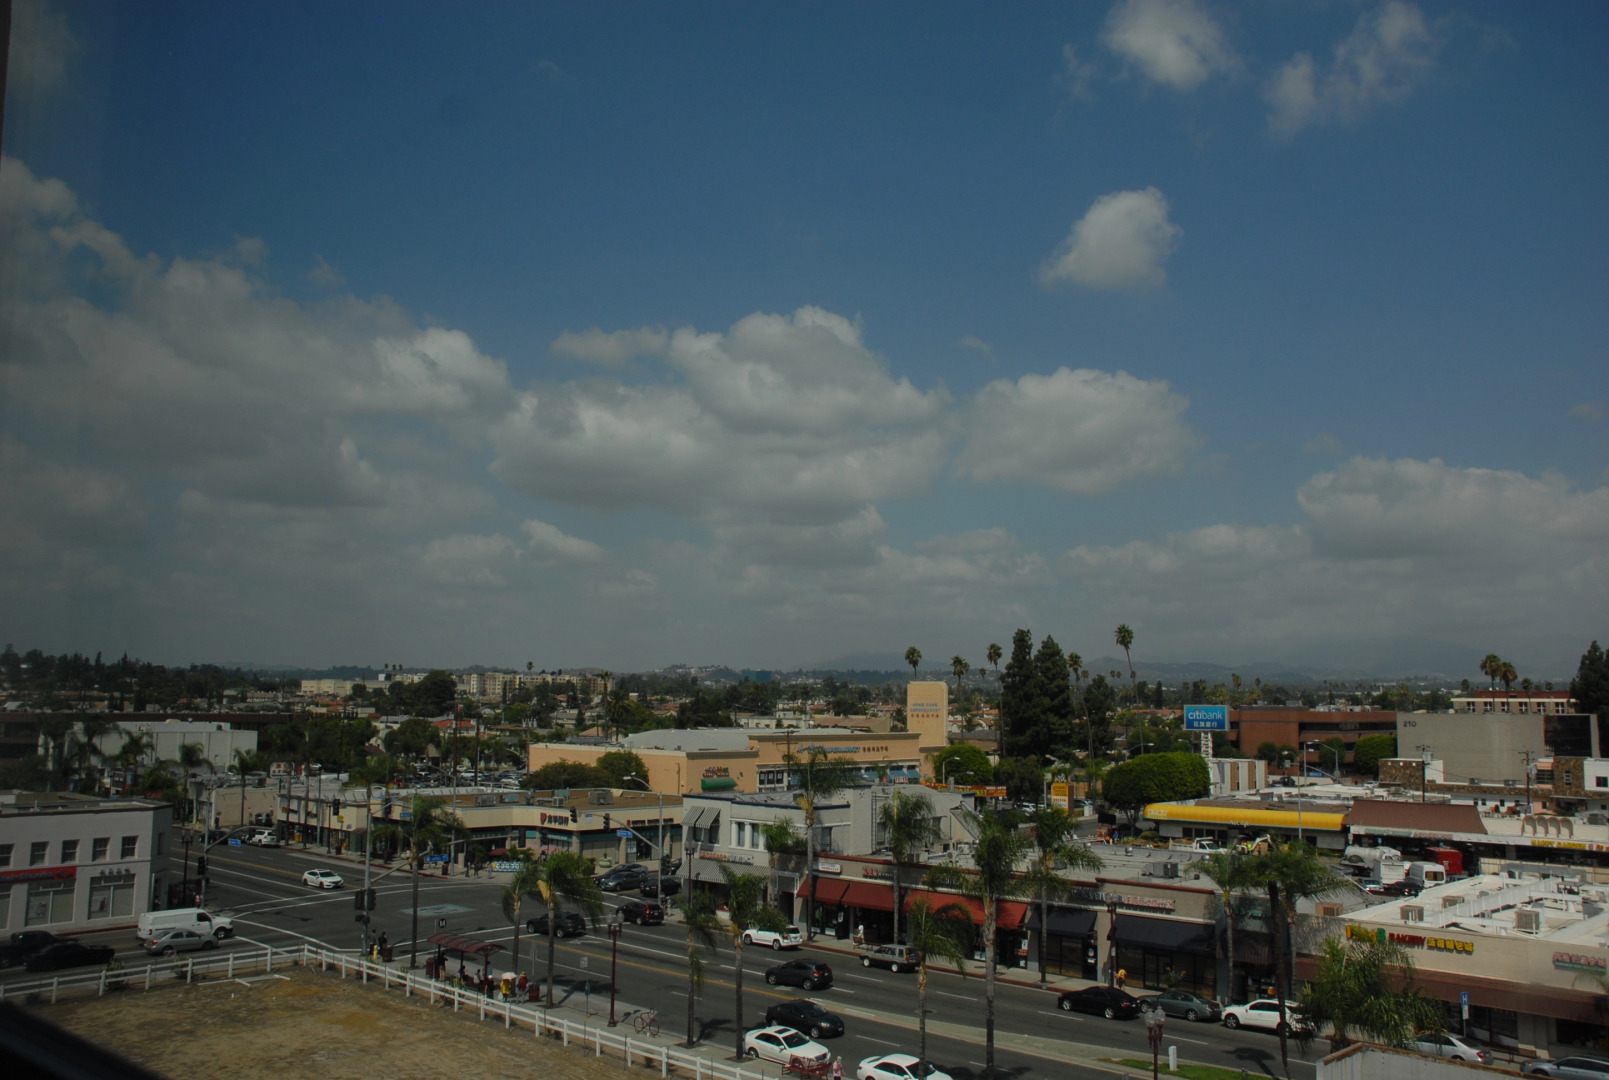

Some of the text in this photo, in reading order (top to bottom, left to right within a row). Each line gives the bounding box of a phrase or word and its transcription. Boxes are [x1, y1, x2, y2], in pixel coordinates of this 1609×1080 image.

[1188, 711, 1222, 720] citibank
[1403, 720, 1417, 728] 210
[1388, 932, 1426, 946] BAKERY
